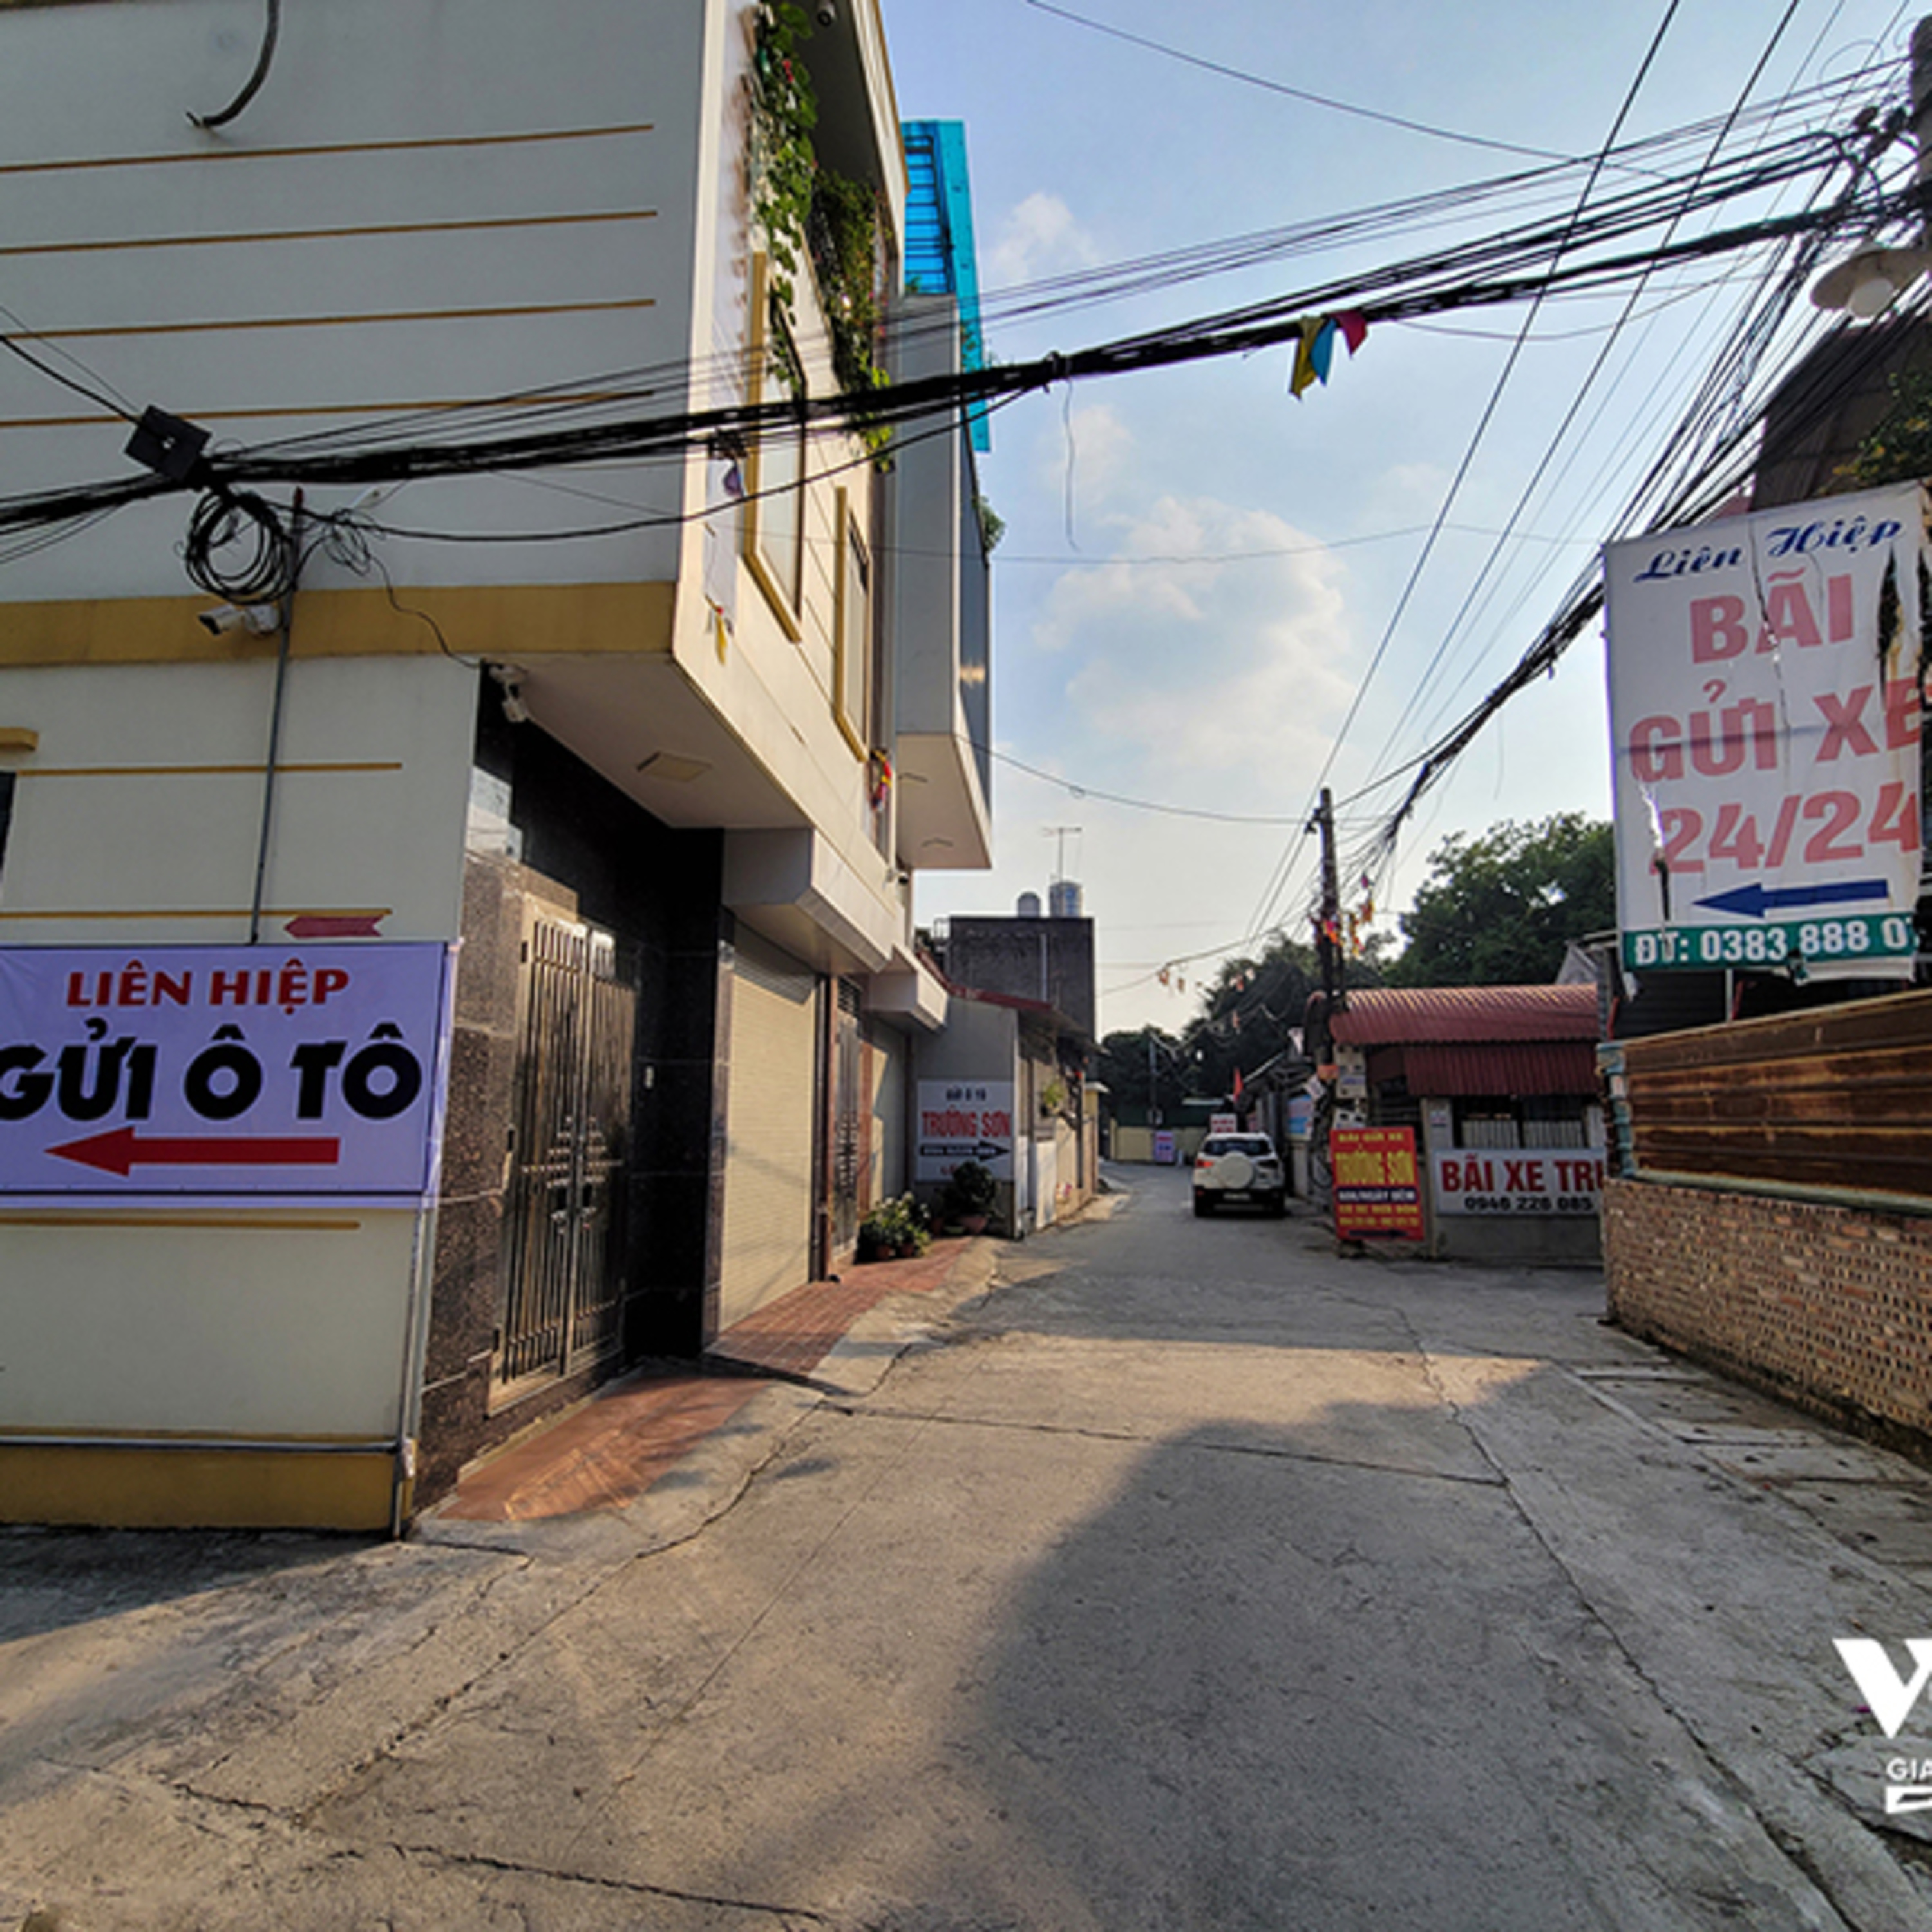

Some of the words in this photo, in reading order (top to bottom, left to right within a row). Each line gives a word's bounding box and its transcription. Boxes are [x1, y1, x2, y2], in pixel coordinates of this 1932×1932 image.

[1634, 546, 1741, 582] Liên
[1767, 516, 1901, 558] Hiệp
[1689, 567, 1854, 663] BÃI
[1629, 679, 1777, 782] GỬI
[1812, 677, 1920, 762] XE
[1649, 781, 1920, 875] 24/24
[1634, 931, 1689, 965] ĐT:
[1701, 927, 1787, 961] 0383
[1799, 920, 1868, 954] 888
[1882, 917, 1911, 949] 0
[67, 960, 191, 1006] LIÊN
[209, 958, 349, 1015] HIỆP
[0, 1017, 158, 1121] GỬI
[184, 1024, 262, 1121] Ô
[290, 1023, 422, 1121] TÔ
[1441, 1153, 1493, 1192] BÃI
[1503, 1160, 1547, 1192] XE
